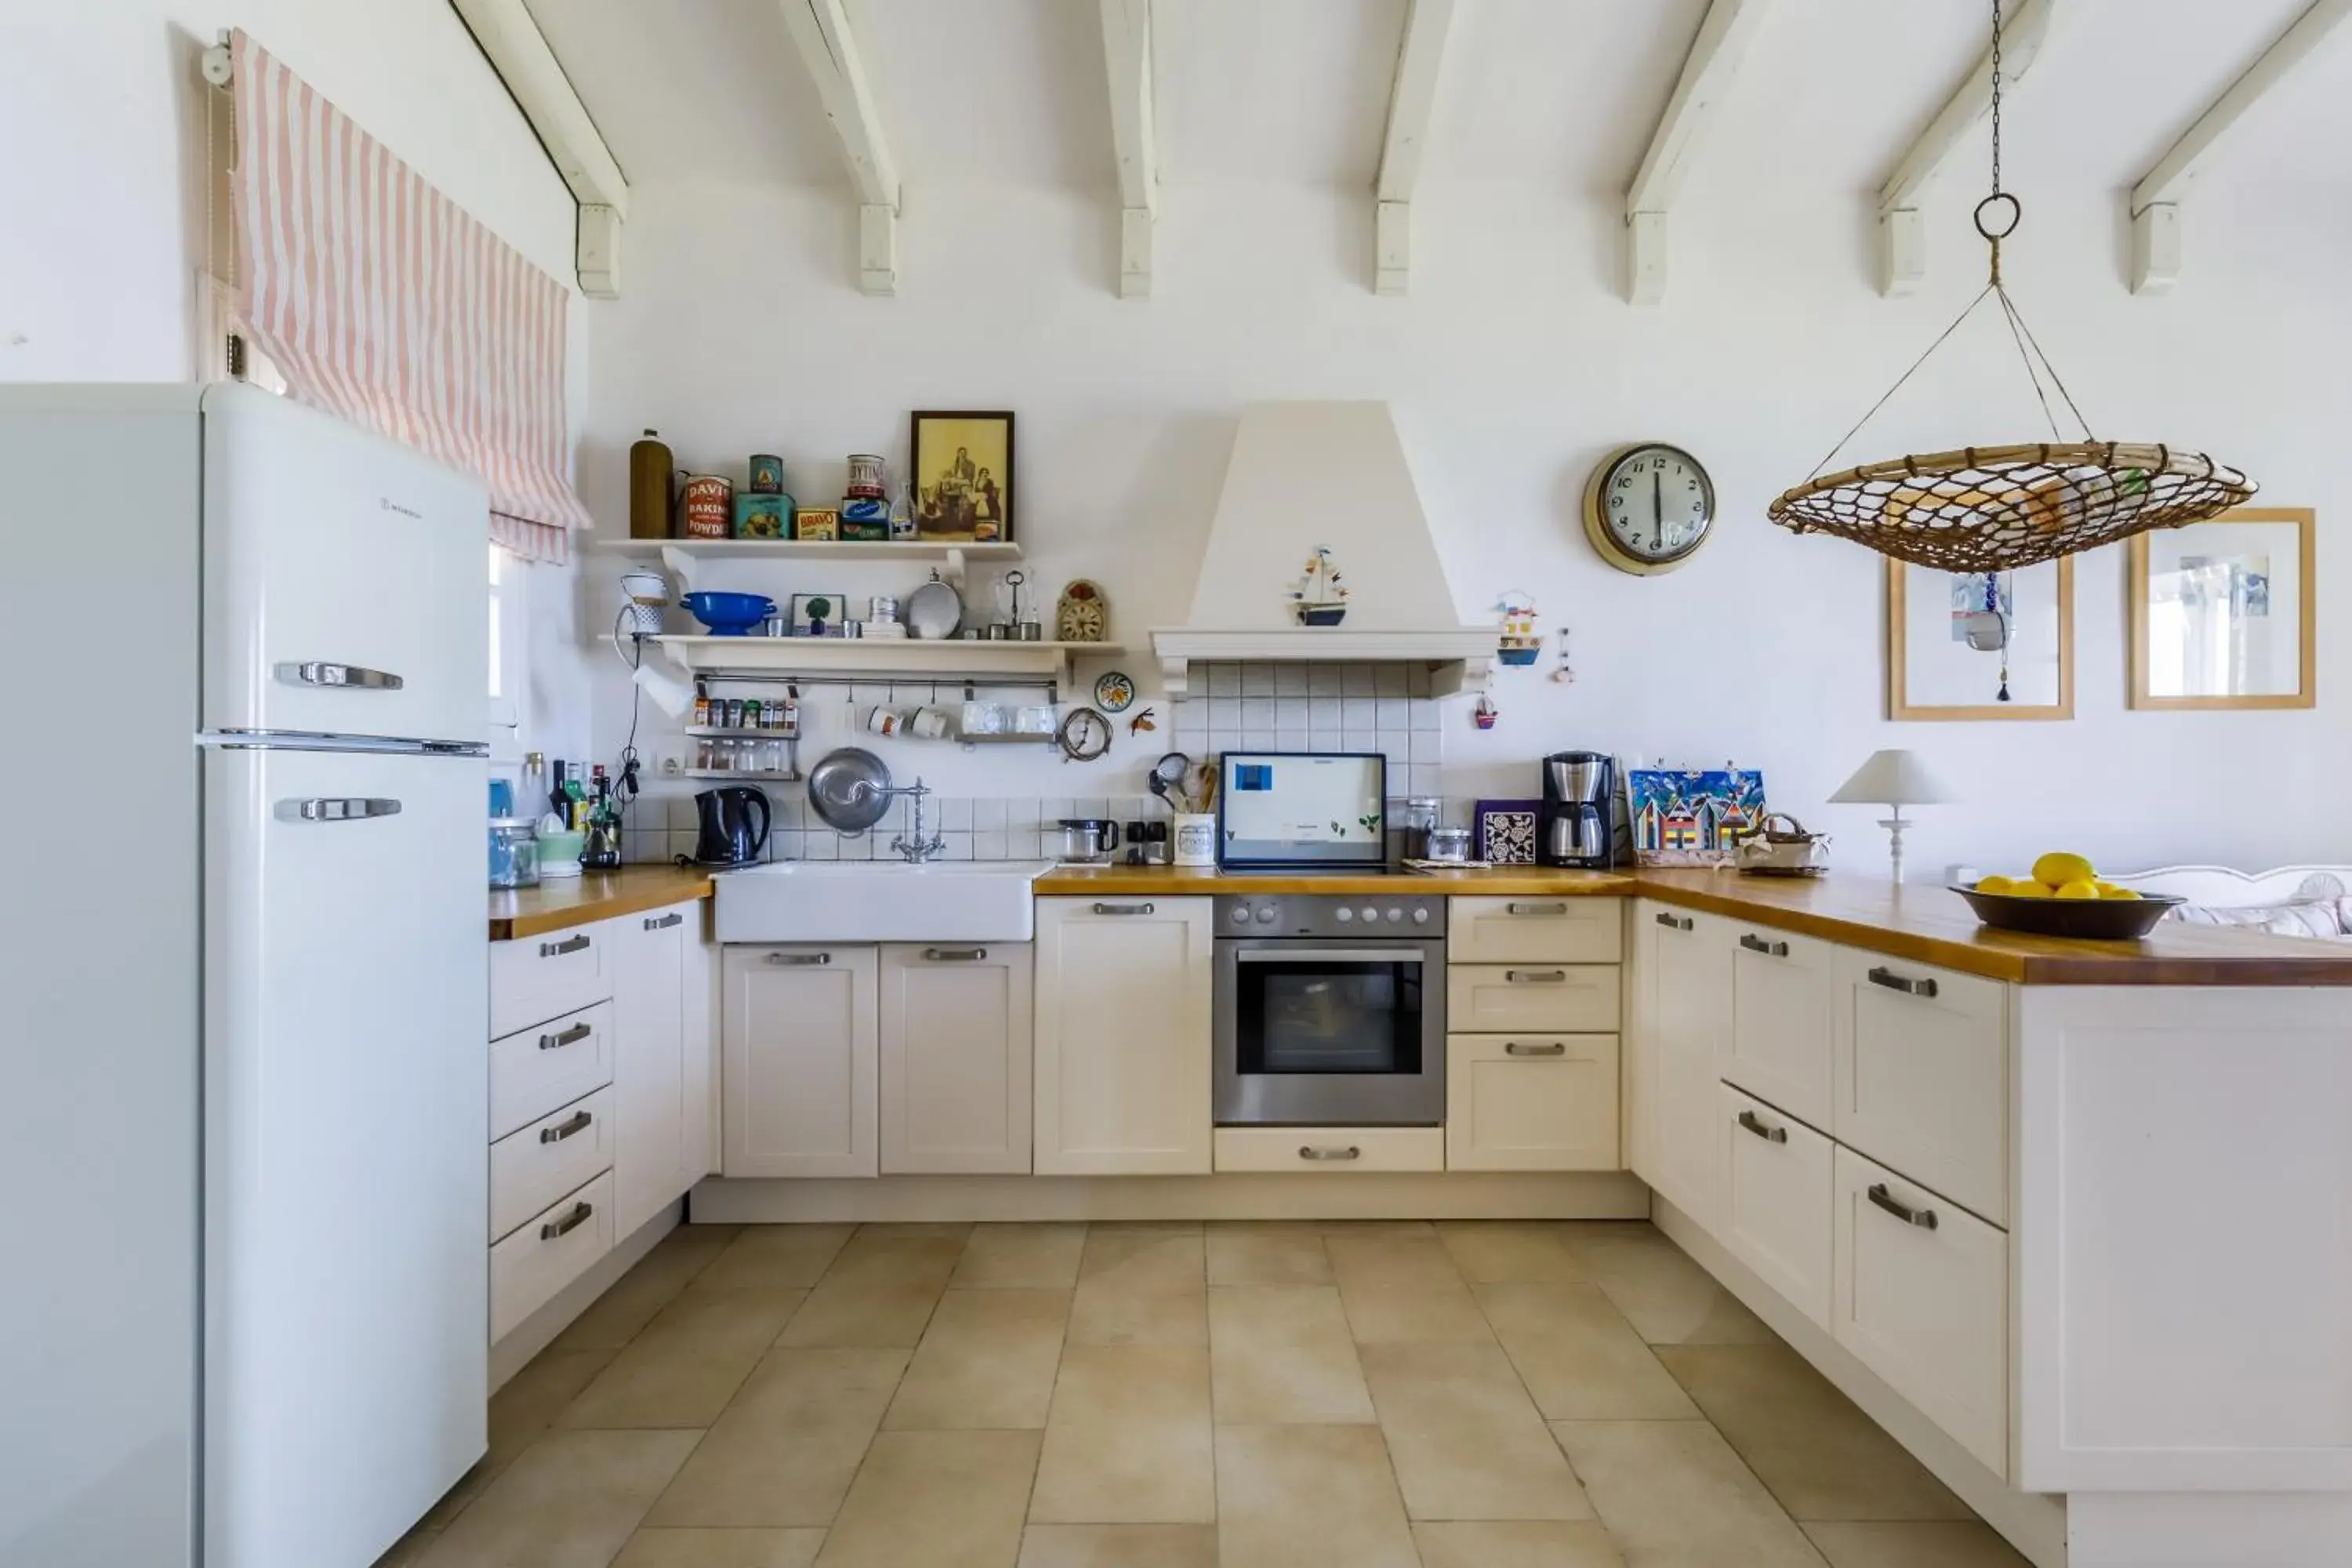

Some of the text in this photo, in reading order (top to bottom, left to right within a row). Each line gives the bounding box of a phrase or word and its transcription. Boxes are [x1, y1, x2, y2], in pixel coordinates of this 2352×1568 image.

[1633, 463, 1644, 473] 11
[1653, 459, 1666, 469] 12
[1677, 466, 1682, 474] 1
[1617, 477, 1632, 488] 10
[1688, 479, 1697, 491] 2
[1611, 495, 1624, 508] 9
[801, 513, 833, 528] BRAVO
[1617, 517, 1628, 528] 8
[1632, 533, 1642, 545] 7
